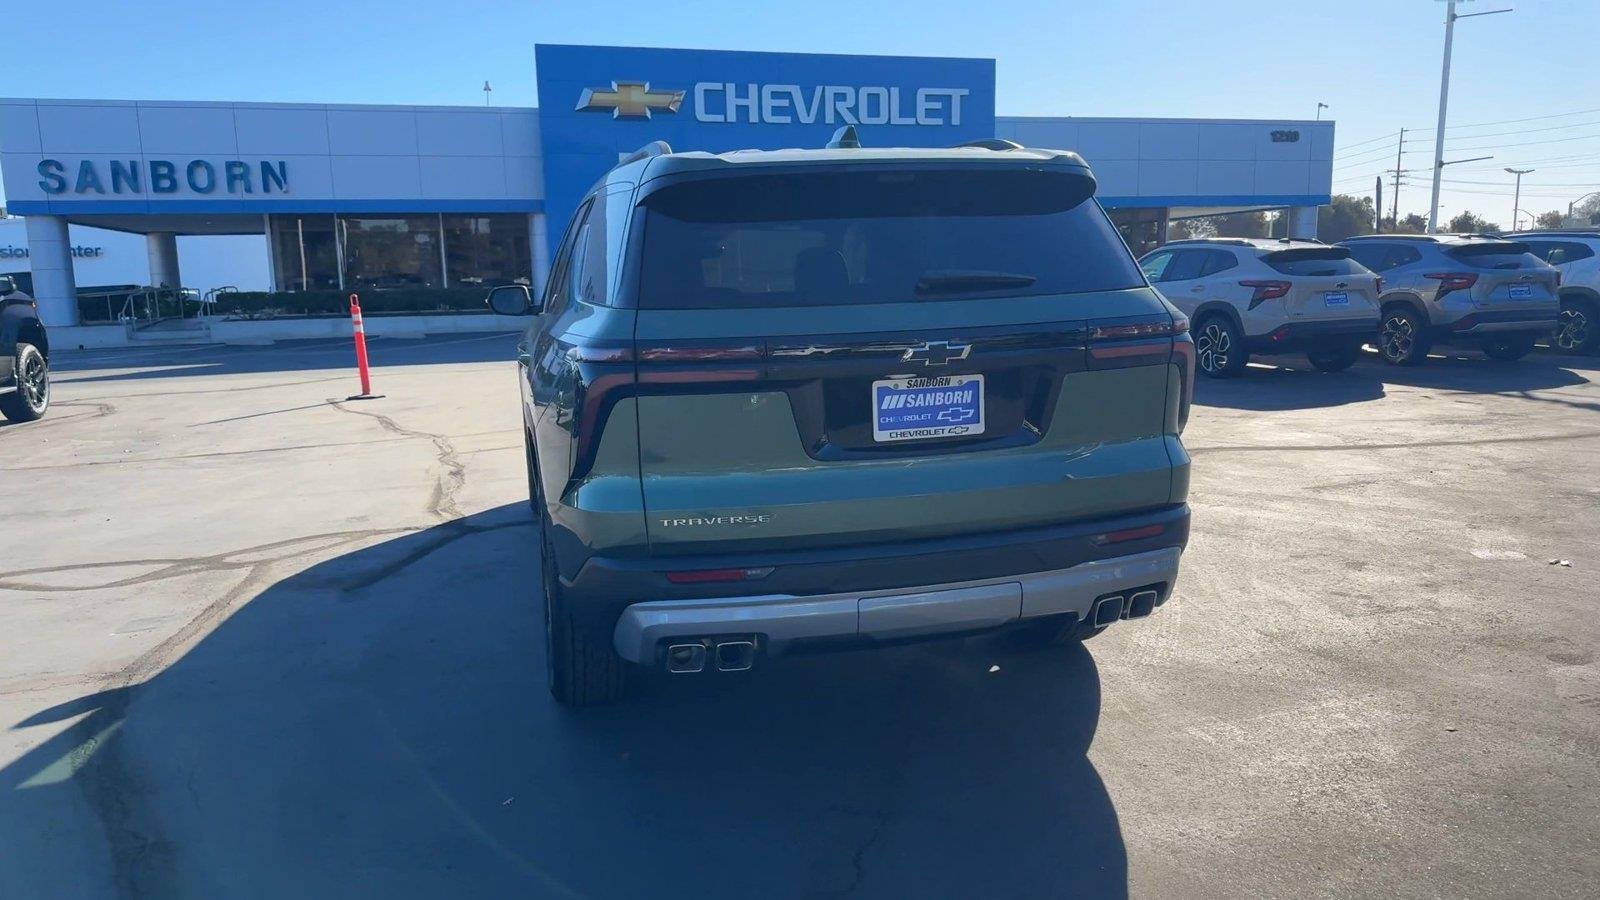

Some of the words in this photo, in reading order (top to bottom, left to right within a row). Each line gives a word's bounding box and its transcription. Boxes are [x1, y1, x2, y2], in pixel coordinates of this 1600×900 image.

[694, 82, 970, 126] CHEVROLET
[37, 158, 289, 195] SANBORN
[906, 378, 952, 389] SANBORN
[906, 390, 973, 408] SANBORN
[880, 413, 932, 423] CHEVROLET
[889, 428, 946, 439] CHEVROLET
[660, 514, 771, 527] TRAVERSE
